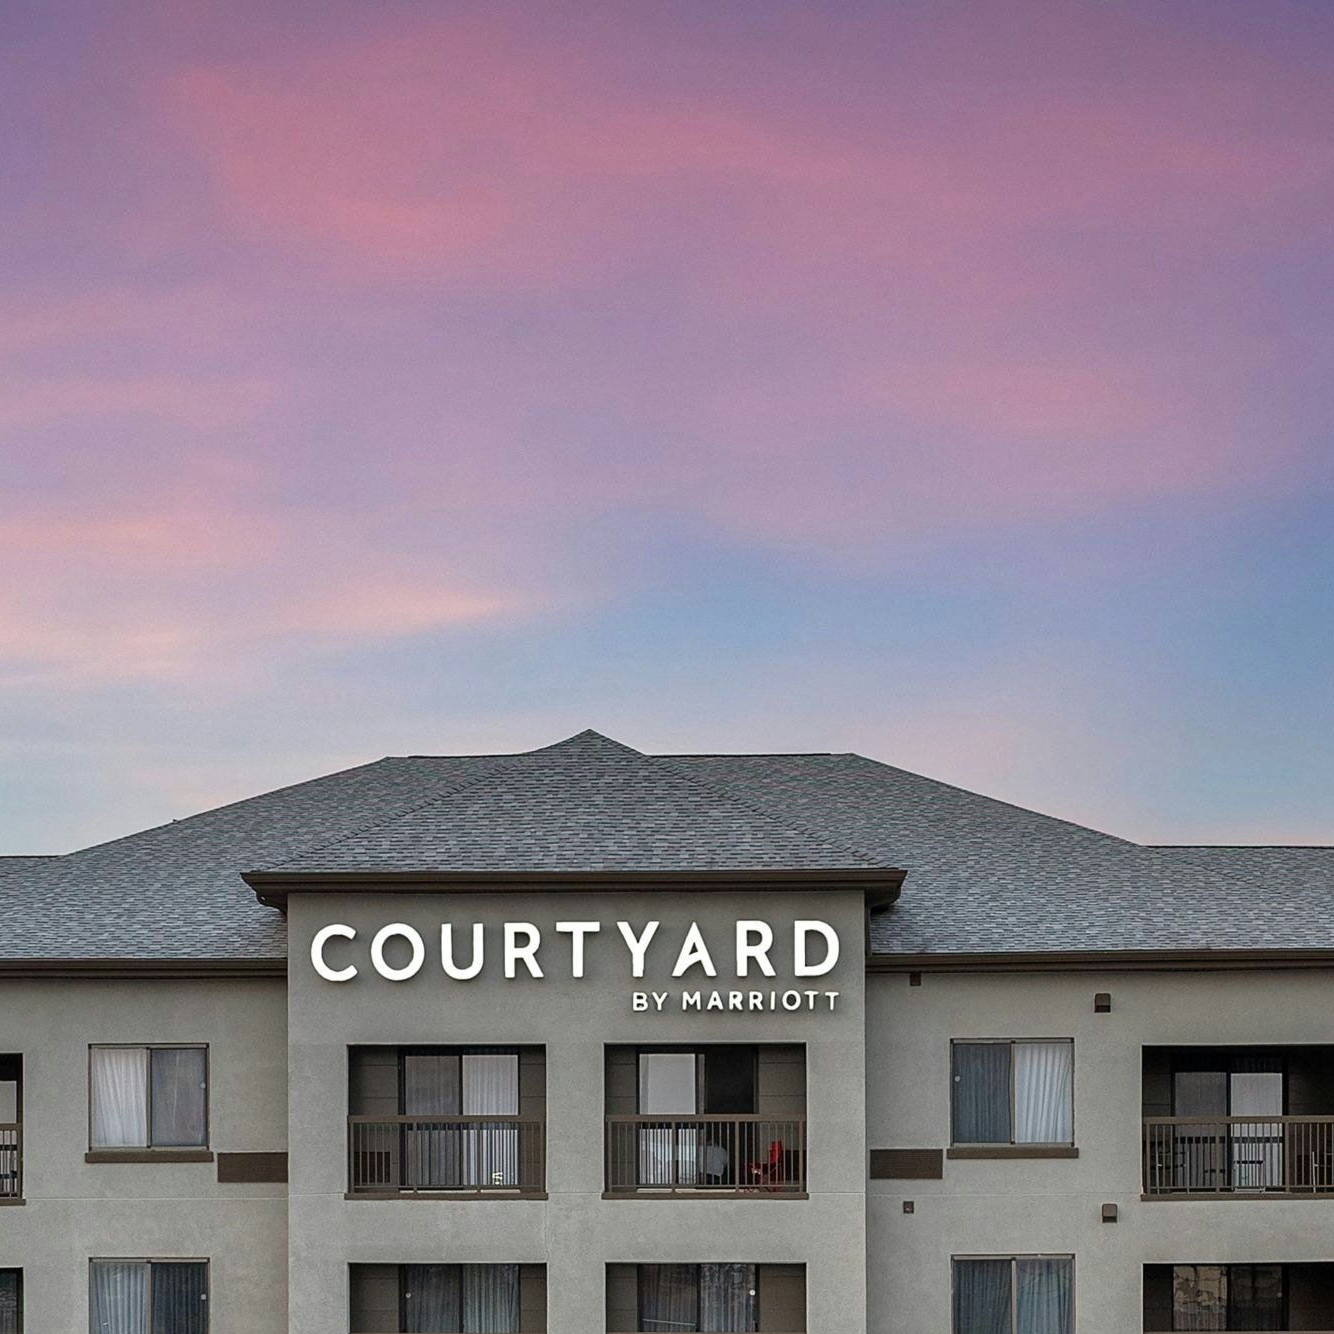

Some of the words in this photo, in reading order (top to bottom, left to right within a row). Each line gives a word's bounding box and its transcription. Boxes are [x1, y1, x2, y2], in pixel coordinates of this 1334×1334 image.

[310, 920, 840, 982] COURTYARD
[632, 991, 668, 1011] BY
[682, 990, 840, 1011] MARRIOTT
